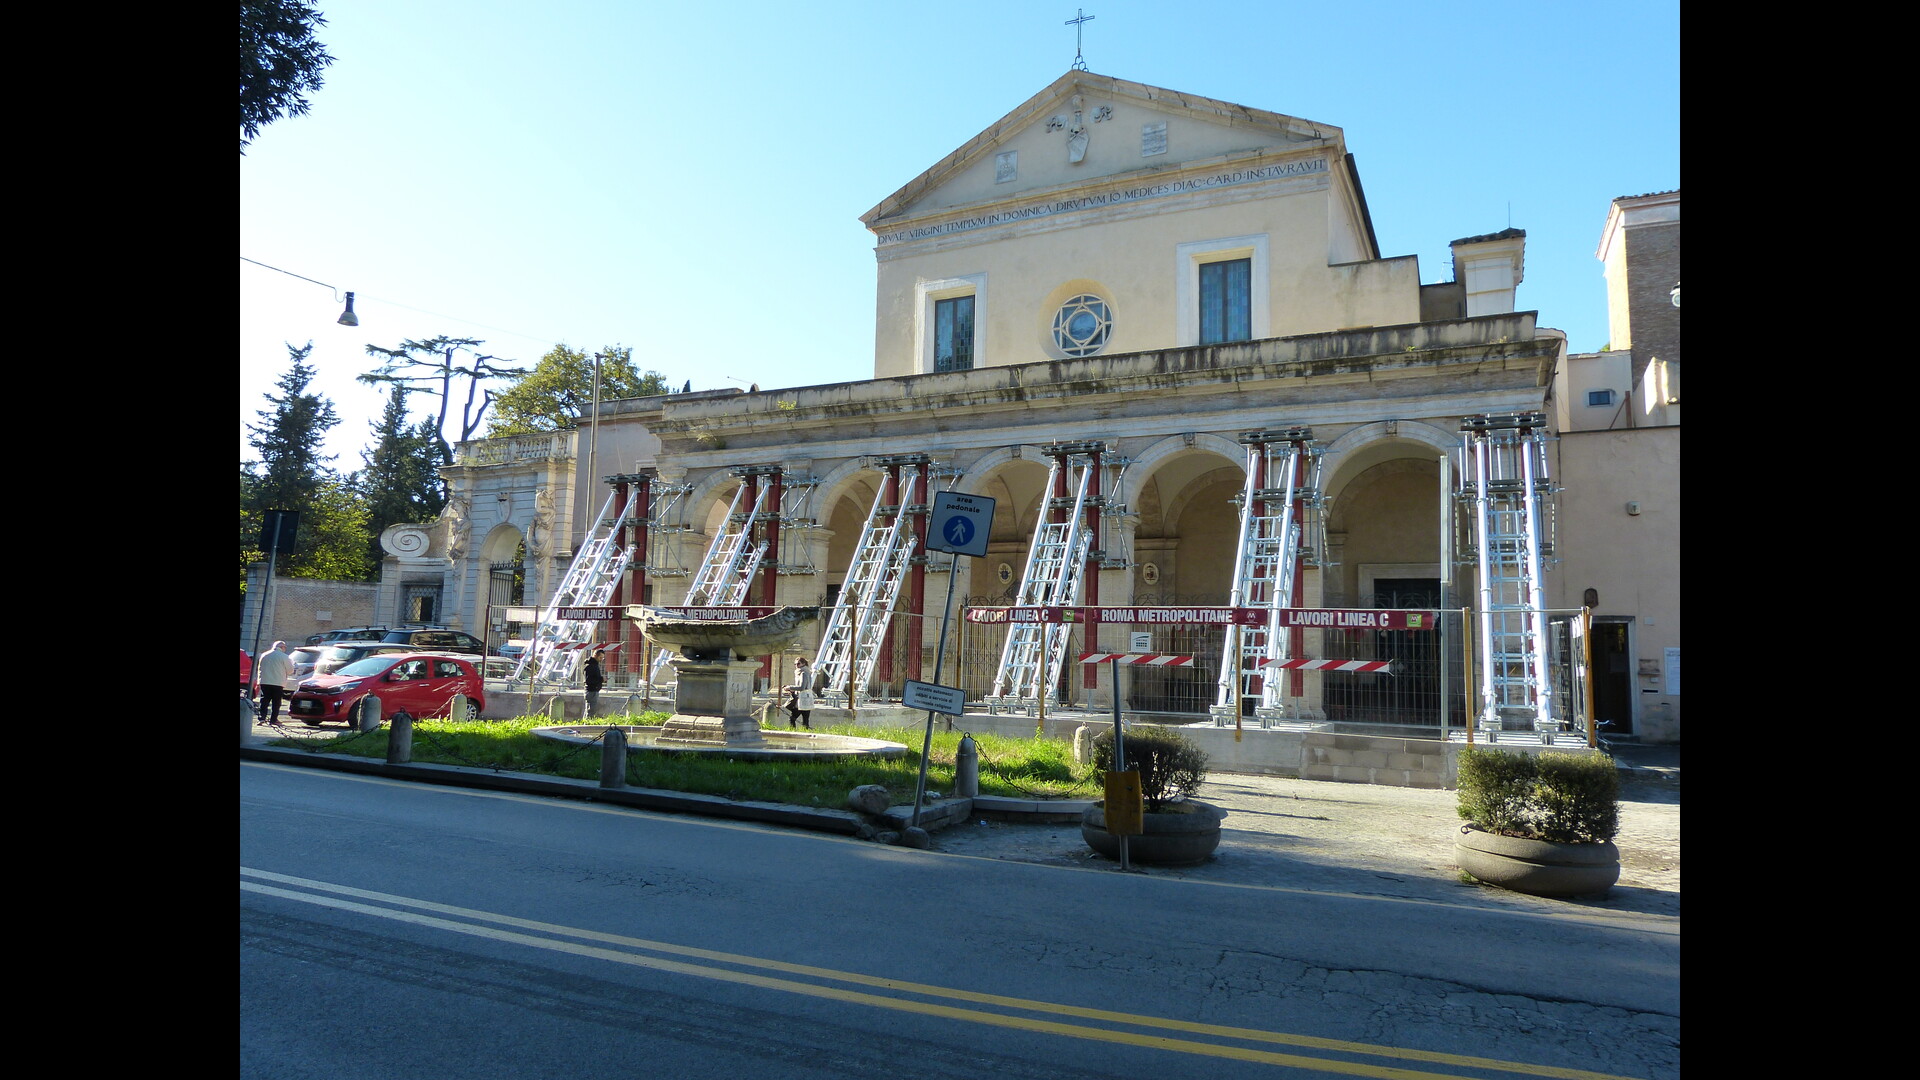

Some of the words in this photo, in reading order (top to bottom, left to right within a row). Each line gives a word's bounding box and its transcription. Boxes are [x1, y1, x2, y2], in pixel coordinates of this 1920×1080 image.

[909, 225, 943, 238] VIRGINI
[988, 213, 1000, 225] IN
[1003, 204, 1052, 222] DOMNICA
[1056, 194, 1107, 212] DIRVTVM
[1124, 184, 1169, 200] MEDICES
[946, 504, 980, 513] pedonale
[561, 607, 586, 620] LAVORI
[587, 608, 607, 620] LINEA
[608, 610, 613, 620] C
[972, 608, 1007, 622] LAVORI
[1009, 609, 1039, 622] LINEA
[1041, 610, 1049, 622] C
[1101, 609, 1135, 622] ROMA
[1138, 609, 1233, 623] METROPOLITANE
[1289, 611, 1334, 626] LAVORI
[1337, 612, 1376, 627] LINEA
[1379, 613, 1389, 627] C
